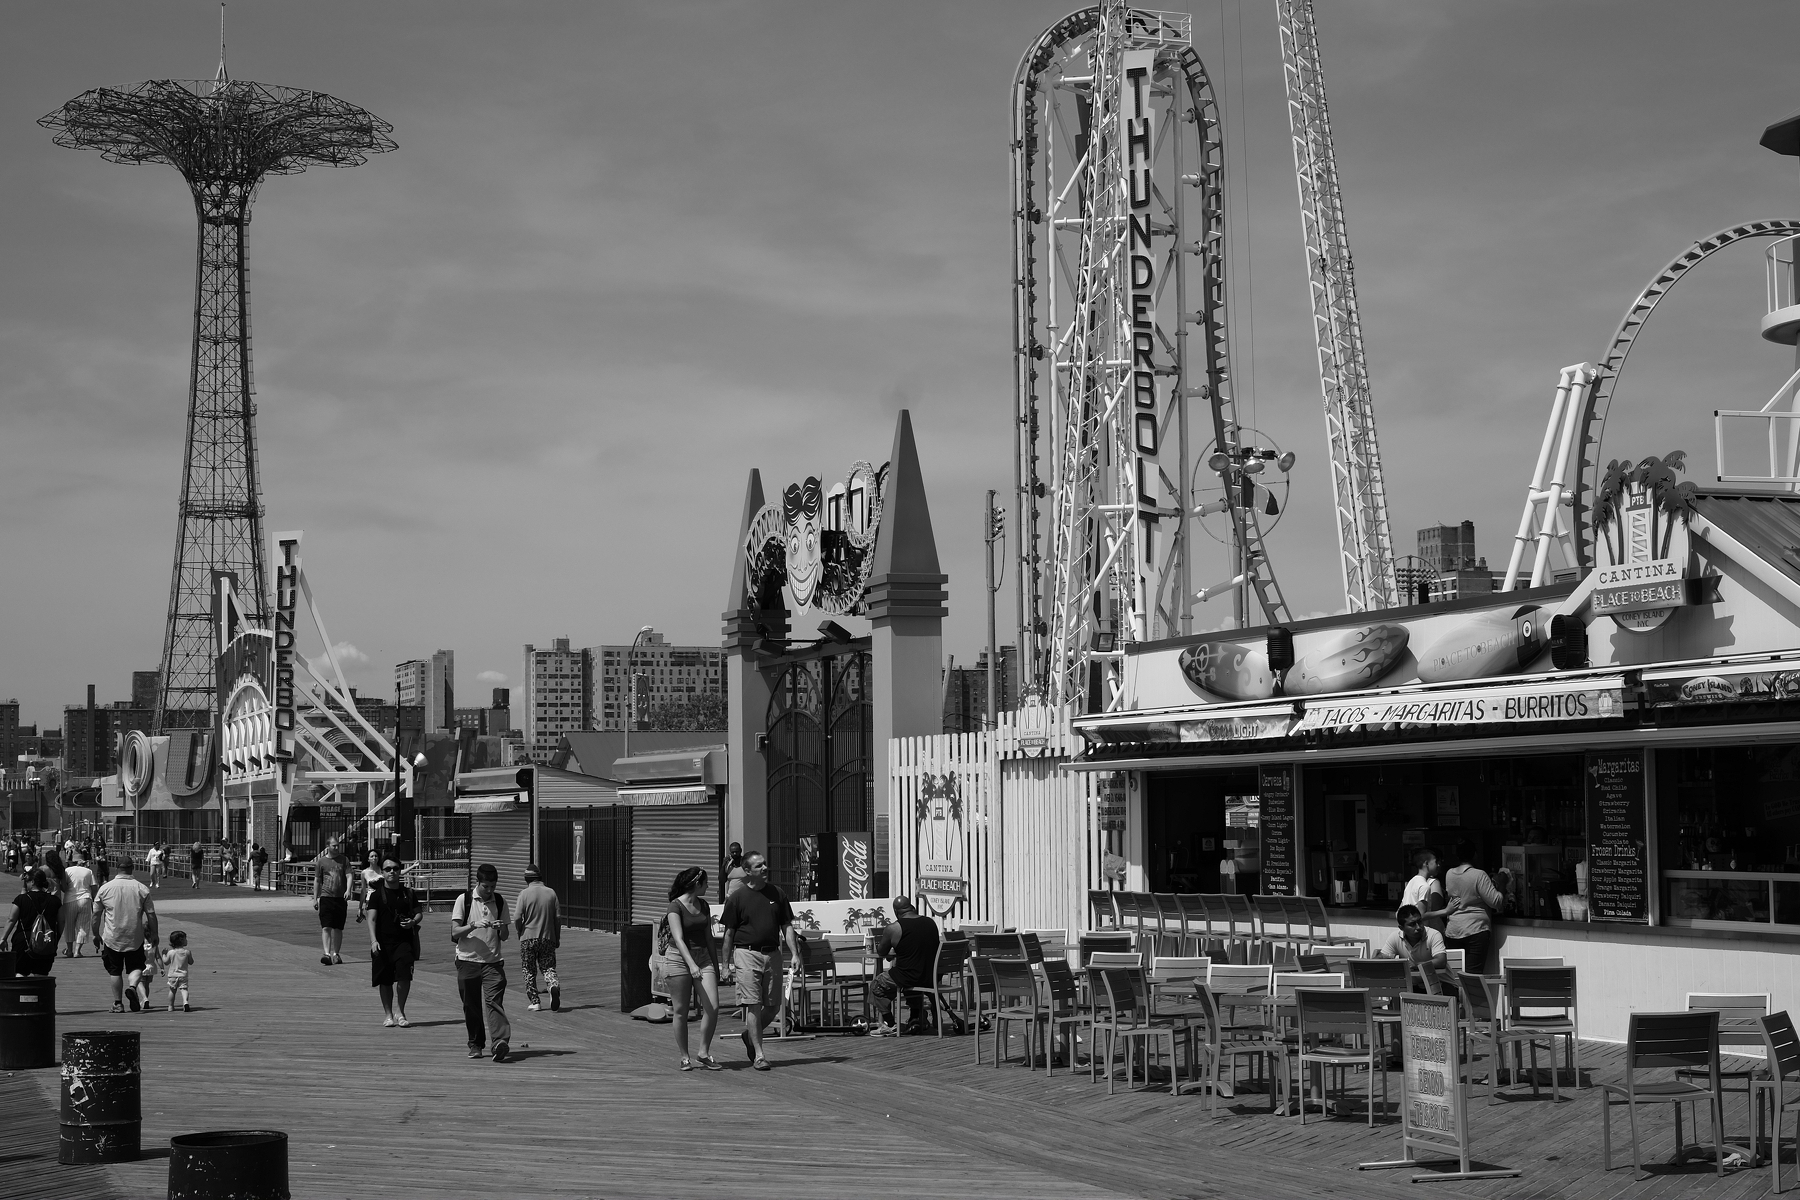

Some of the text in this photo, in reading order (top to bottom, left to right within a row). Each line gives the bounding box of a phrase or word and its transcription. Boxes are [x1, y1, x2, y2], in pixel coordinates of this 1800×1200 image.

[1127, 67, 1159, 564] THUNDERBOLT
[1631, 496, 1644, 506] PTB
[1599, 563, 1677, 584] CANTINA
[1593, 592, 1629, 610] PLACE
[1641, 585, 1681, 603] BEACH
[1622, 610, 1665, 622] CONEY ISLAND
[275, 539, 297, 784] THUNDERBOLT
[1433, 632, 1515, 671] PLACE TO BEACH
[1321, 707, 1371, 726] TACOS
[1381, 699, 1486, 722] MARGARITAS
[1504, 693, 1588, 720] BURRITOS
[1233, 723, 1258, 739] LIGHT
[1598, 757, 1640, 777] Margaritas
[1591, 844, 1637, 857] Frozen Drinks
[925, 864, 953, 873] CANTINA
[920, 879, 938, 890] PLACE
[942, 880, 960, 891] BEACH
[1411, 1034, 1446, 1064] BEVERAGES
[1418, 1068, 1444, 1097] BEYOND
[1413, 1100, 1449, 1131] THIS POINT
